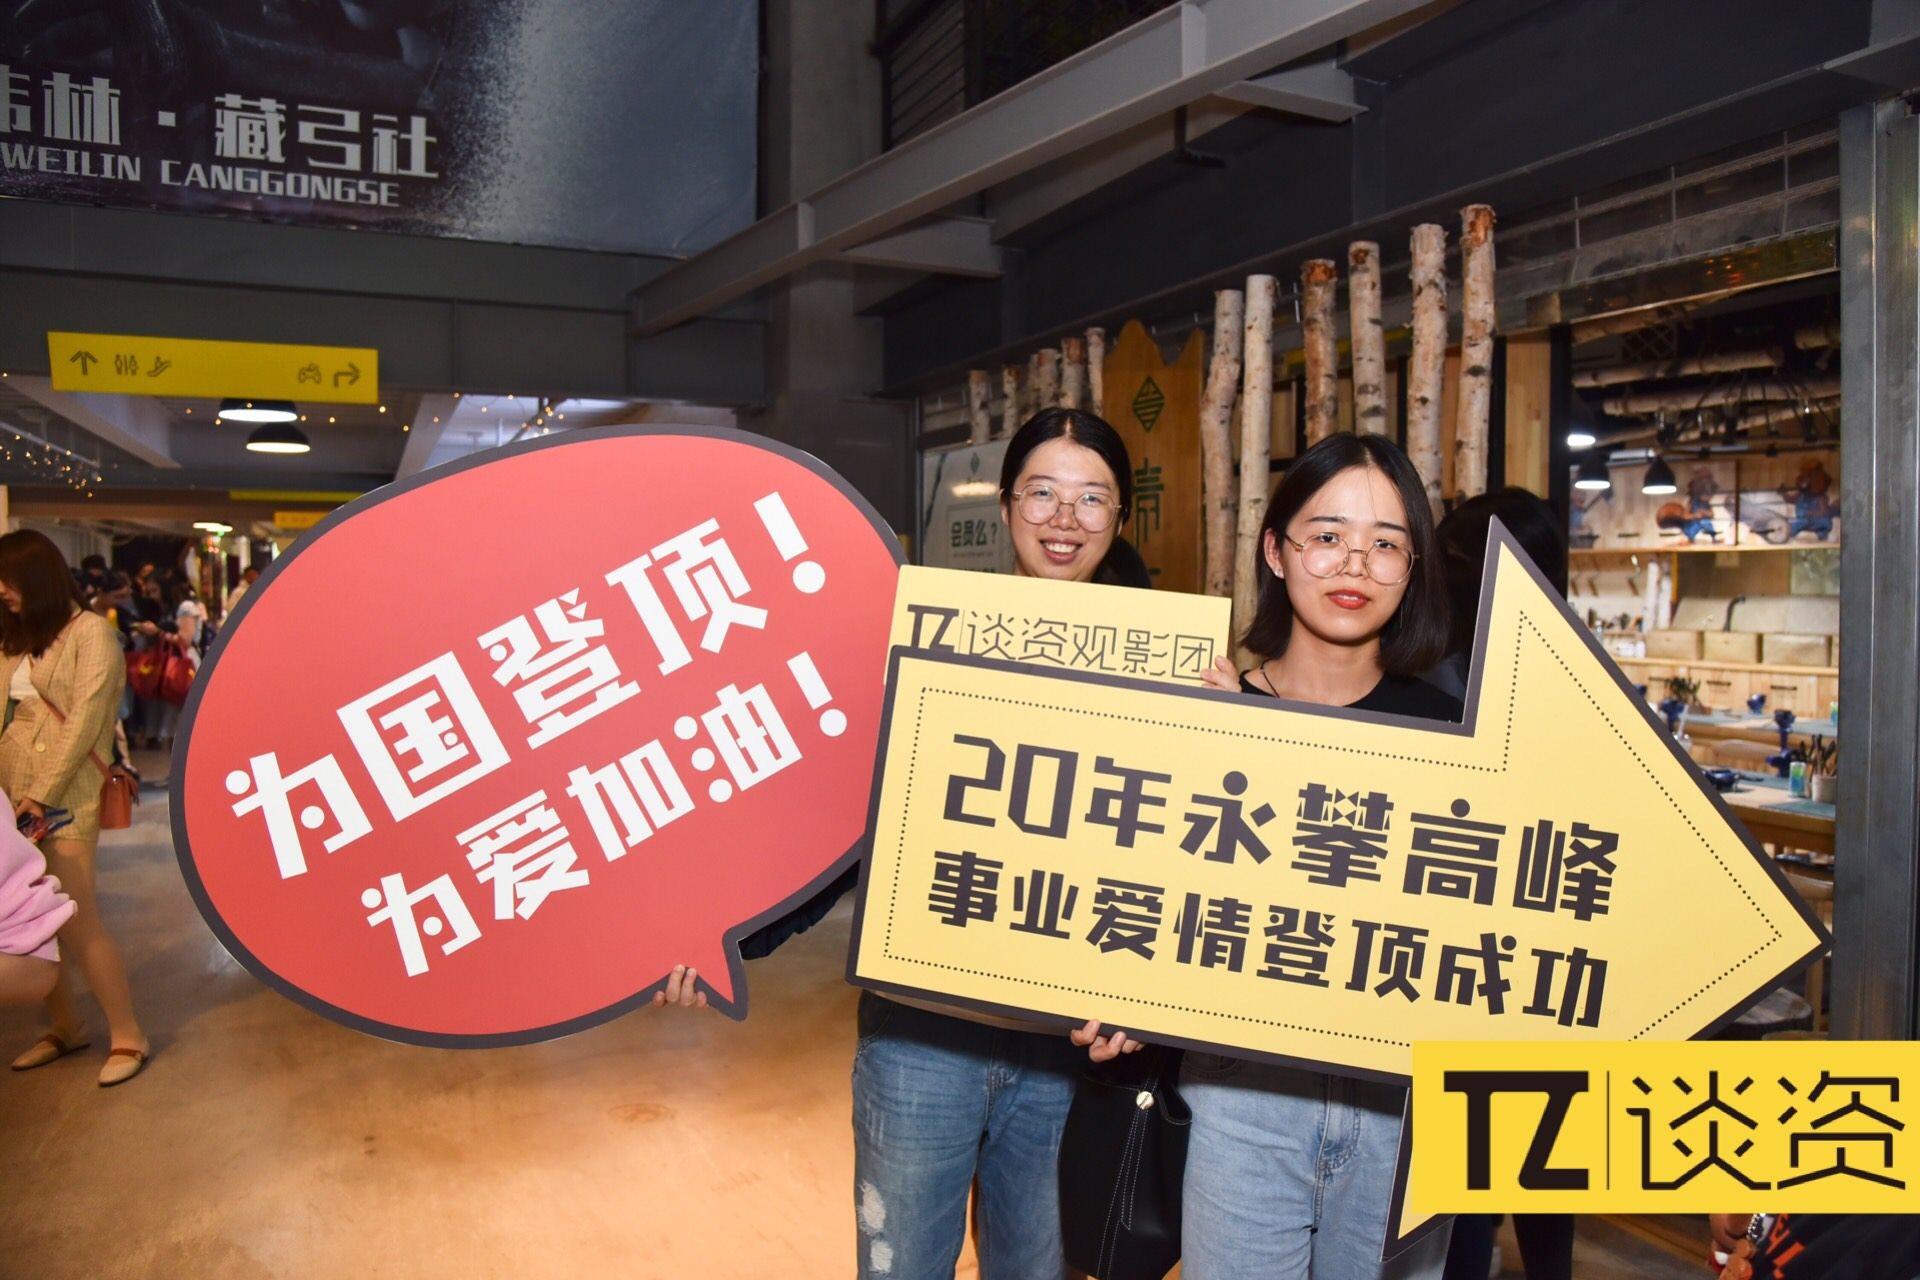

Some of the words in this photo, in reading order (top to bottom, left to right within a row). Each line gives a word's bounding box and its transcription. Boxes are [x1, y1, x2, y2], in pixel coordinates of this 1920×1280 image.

[160, 159, 400, 207] CANGGONGSE
[225, 491, 826, 879] 为国登顶！
[967, 611, 1215, 680] 谈资观影团
[361, 651, 848, 977] 为爱加油！
[943, 733, 1620, 922] 20年永攀高峰
[928, 850, 1609, 1028] 事业爱情登顶成功
